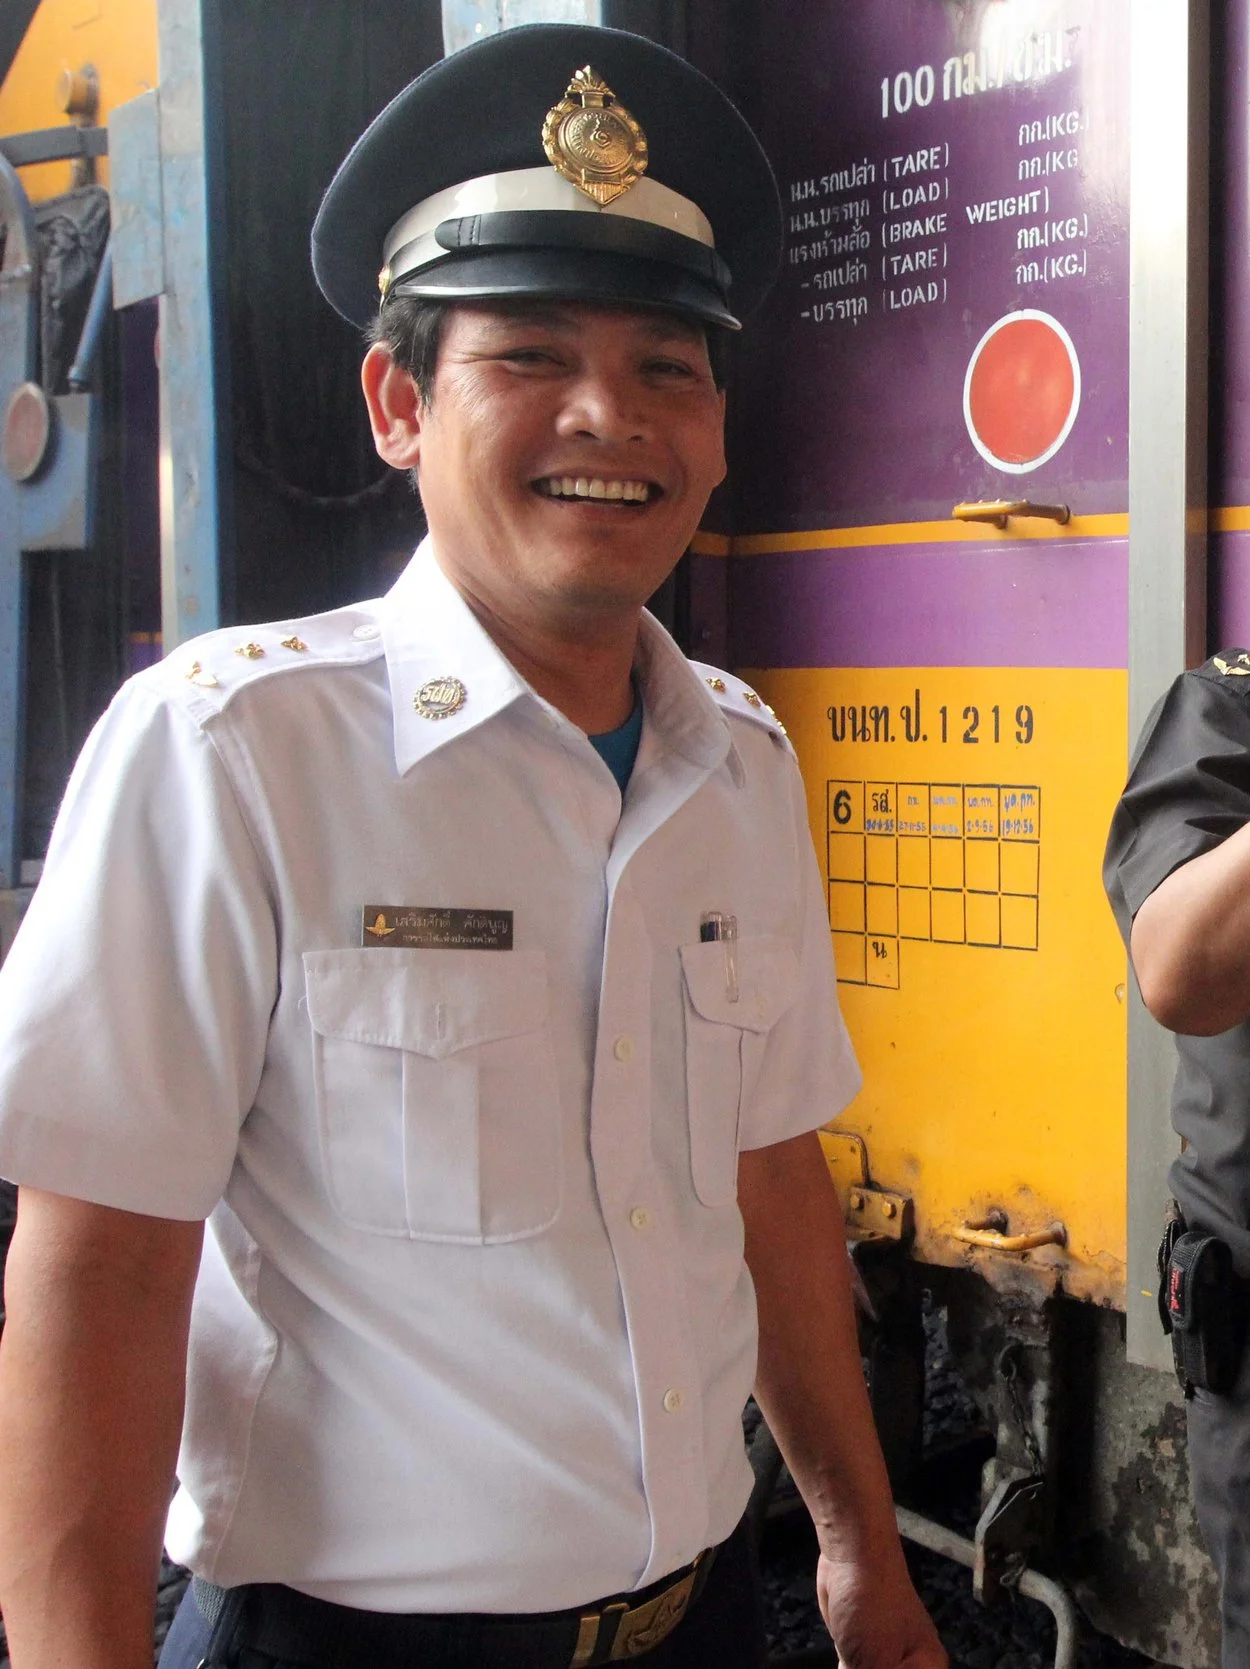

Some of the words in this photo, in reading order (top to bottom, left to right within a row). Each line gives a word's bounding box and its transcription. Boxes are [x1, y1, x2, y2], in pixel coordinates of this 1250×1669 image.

[880, 66, 934, 118] 100
[965, 186, 1050, 225] WEIGHT)
[834, 789, 852, 824] 6
